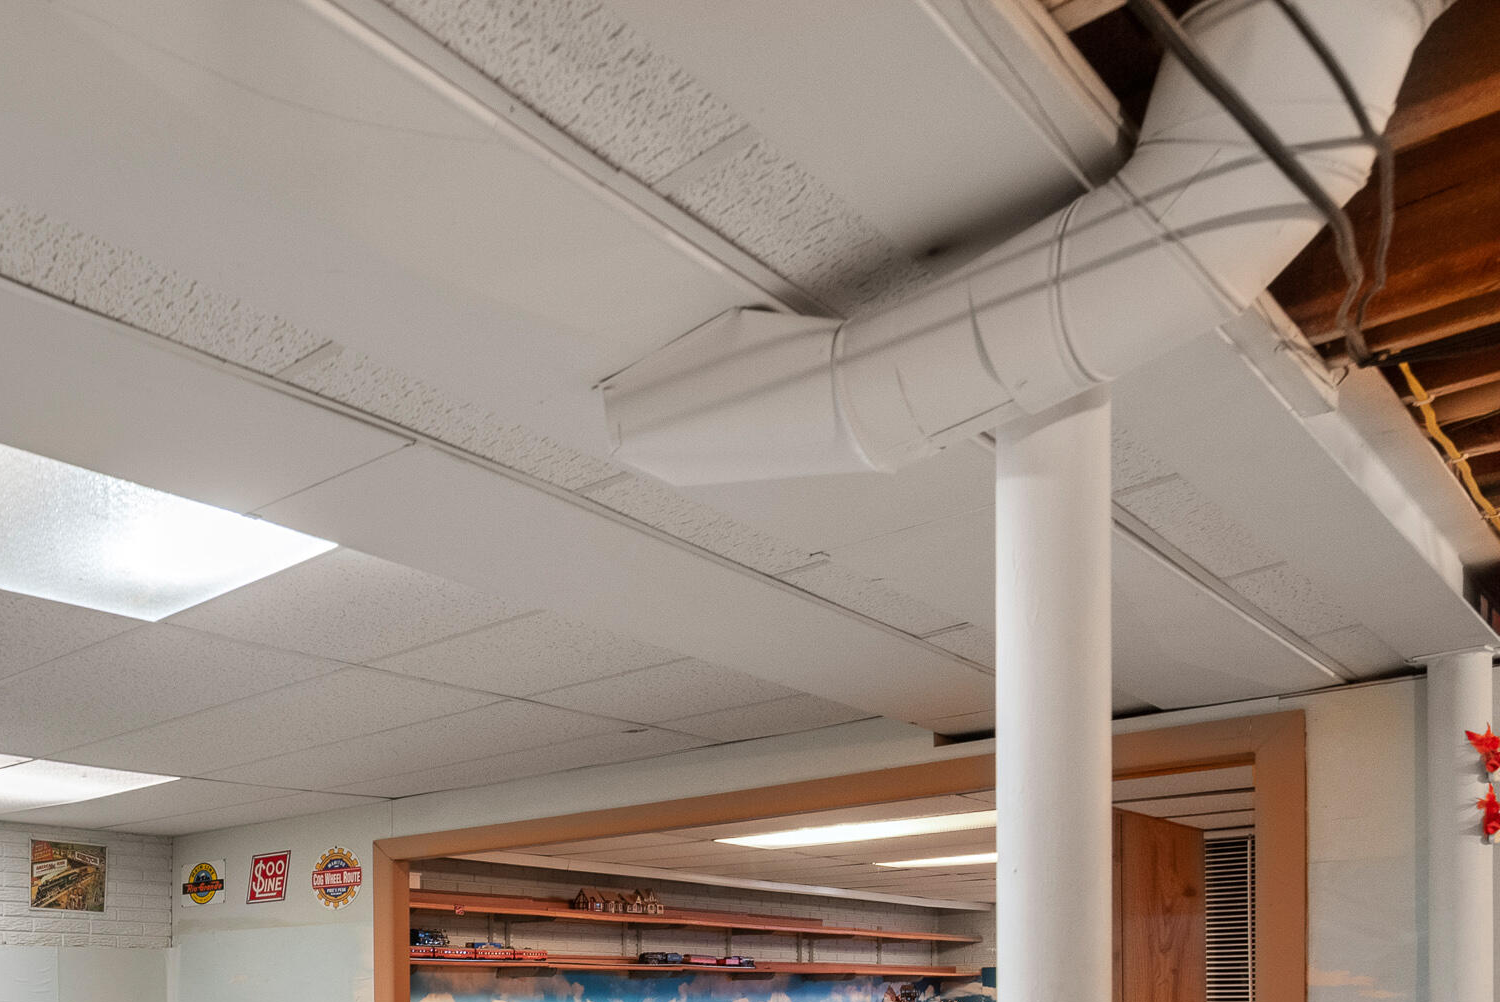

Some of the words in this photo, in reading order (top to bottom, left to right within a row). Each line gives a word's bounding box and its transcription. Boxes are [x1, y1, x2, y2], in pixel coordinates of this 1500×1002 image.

[313, 873, 324, 886] COG
[324, 871, 343, 885] WHEEL
[343, 870, 361, 883] ROUTE
